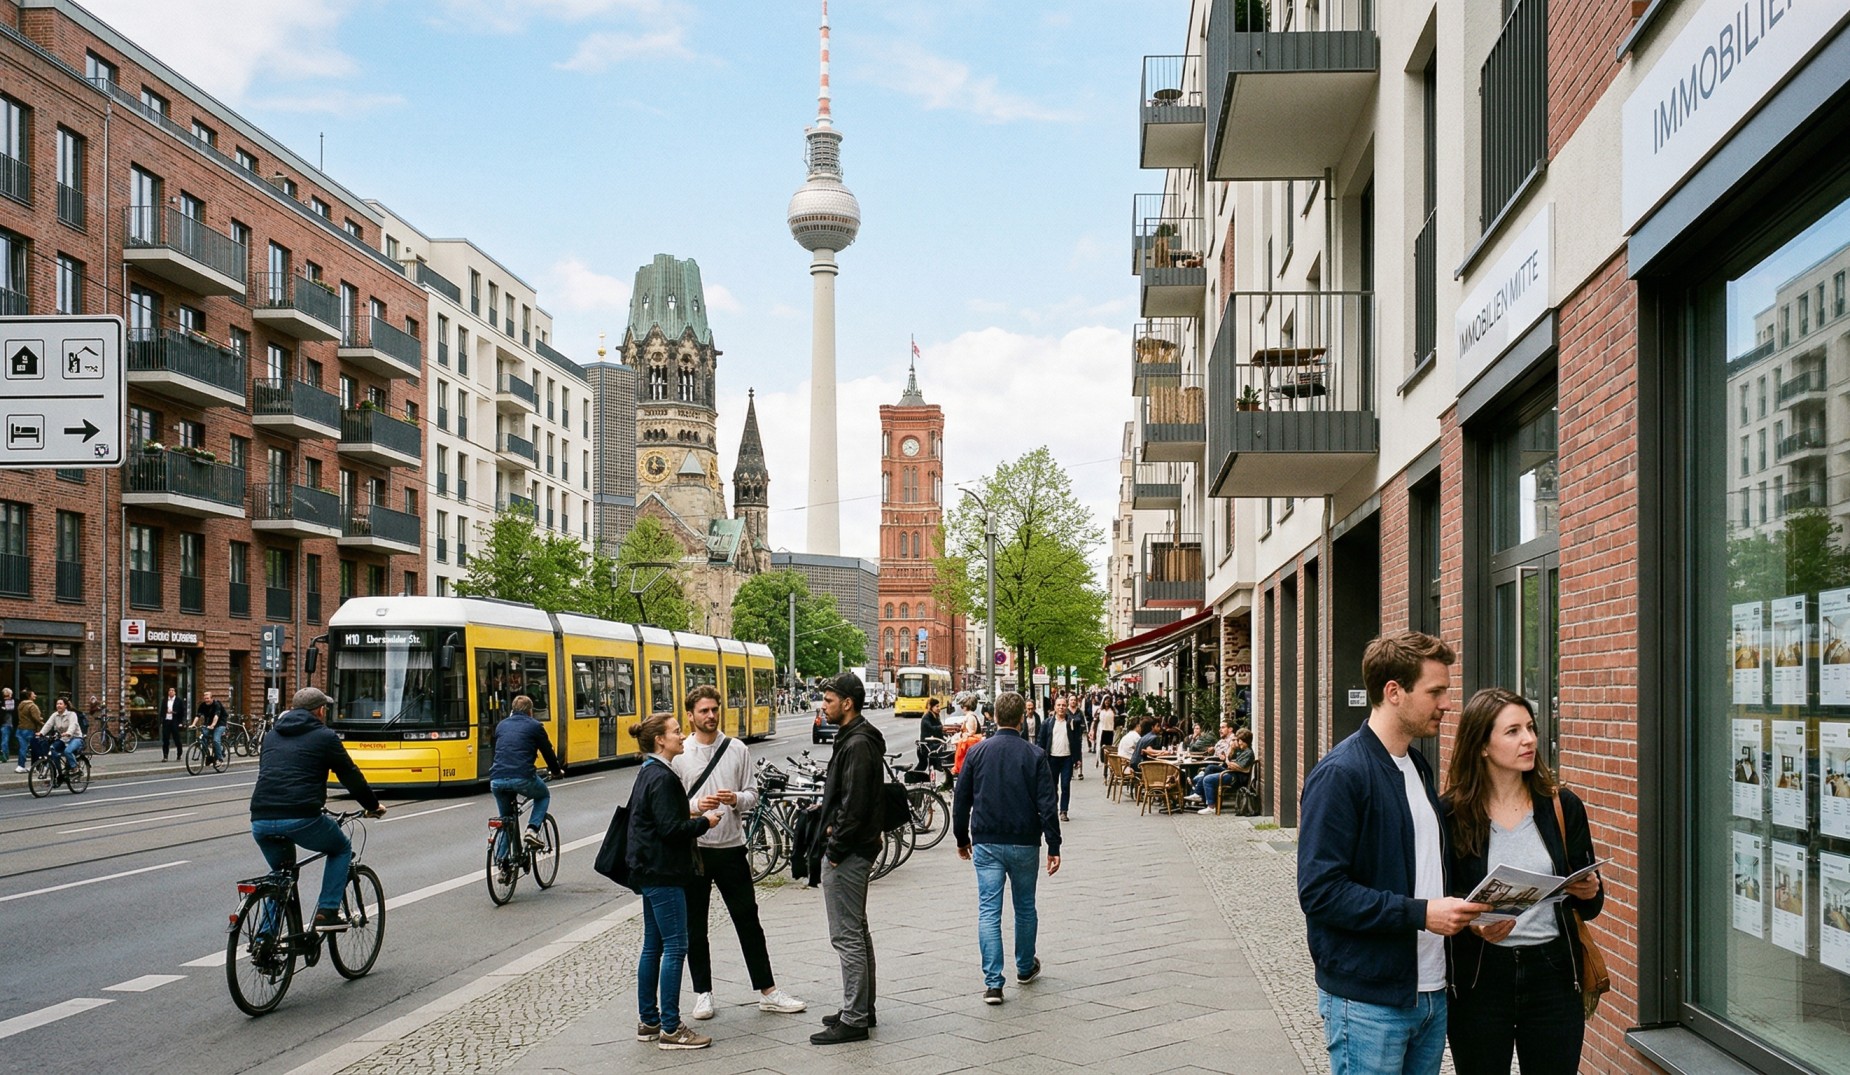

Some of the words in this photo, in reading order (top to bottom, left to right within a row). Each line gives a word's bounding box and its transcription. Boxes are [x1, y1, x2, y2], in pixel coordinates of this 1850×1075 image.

[1653, 0, 1792, 155] IMMOBILIE
[1460, 283, 1508, 359] IMMOBILIEN
[1510, 249, 1538, 307] MITTE
[345, 633, 360, 645] M10
[408, 634, 421, 644] Str.
